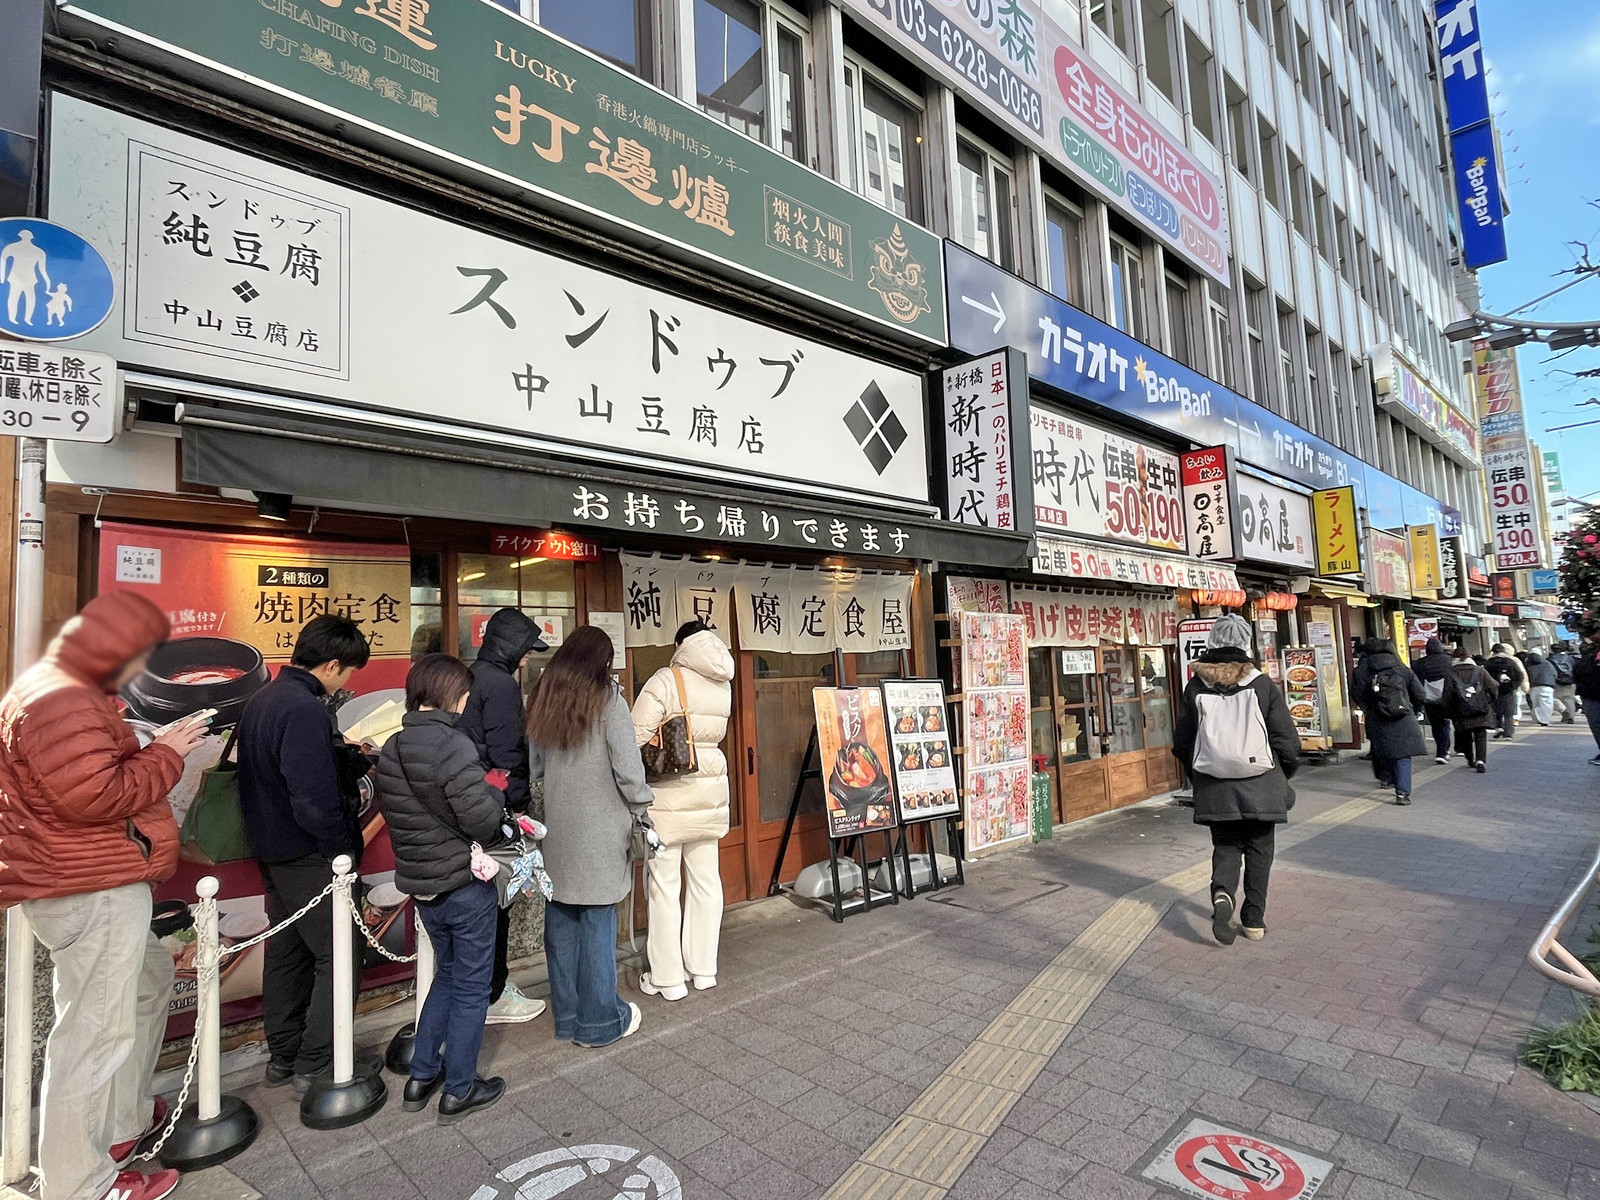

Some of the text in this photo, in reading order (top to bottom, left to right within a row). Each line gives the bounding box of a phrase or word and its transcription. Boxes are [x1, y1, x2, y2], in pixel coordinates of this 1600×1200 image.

[257, 0, 440, 83] CHAFING DISH
[319, 0, 437, 50] 運
[940, 0, 1038, 77] の森
[494, 40, 577, 94] LUCKY
[900, 0, 1041, 131] 03-6228-0056
[491, 84, 736, 237] 打邊爐
[1062, 119, 1124, 192] ドライヘッドスパ
[1066, 61, 1213, 221] 全身もみほぐし
[166, 180, 322, 234] スンドゥブ
[1127, 174, 1178, 233] 足つぼリフレ
[1466, 165, 1491, 227] BanBan
[162, 210, 323, 287] 純豆腐
[164, 299, 320, 353] 中山豆腐店
[449, 265, 805, 400] スンドゥブ
[1038, 315, 1129, 392] カラオケ
[955, 366, 984, 390] 新橋
[1142, 369, 1212, 418] BanBan
[511, 363, 765, 455] 中山豆腐店
[947, 394, 988, 528] 新時代
[991, 361, 1011, 528] 日本一のパリモチ鶏皮
[1103, 442, 1138, 484] 伝串
[1186, 455, 1216, 469] ちょい
[1273, 429, 1314, 474] カラオケ
[1032, 437, 1100, 514] 時代
[1147, 457, 1177, 496] 生中
[1200, 467, 1223, 481] 飲み
[1491, 466, 1525, 484] 伝串
[572, 485, 910, 554] お持ち帰りできます
[1194, 493, 1218, 558] 日高屋
[1213, 484, 1226, 526] 中華食堂
[1240, 493, 1295, 553] 日高屋
[1323, 491, 1346, 557] ラーメン
[1496, 512, 1531, 529] 生中
[496, 535, 597, 557] テイクアウト窓口
[1327, 559, 1352, 572] 豚山
[265, 567, 324, 585] 2種類の
[254, 591, 402, 624] 焼肉定食
[627, 581, 906, 638] 純豆腐定食屋
[847, 694, 861, 738] ビスク
